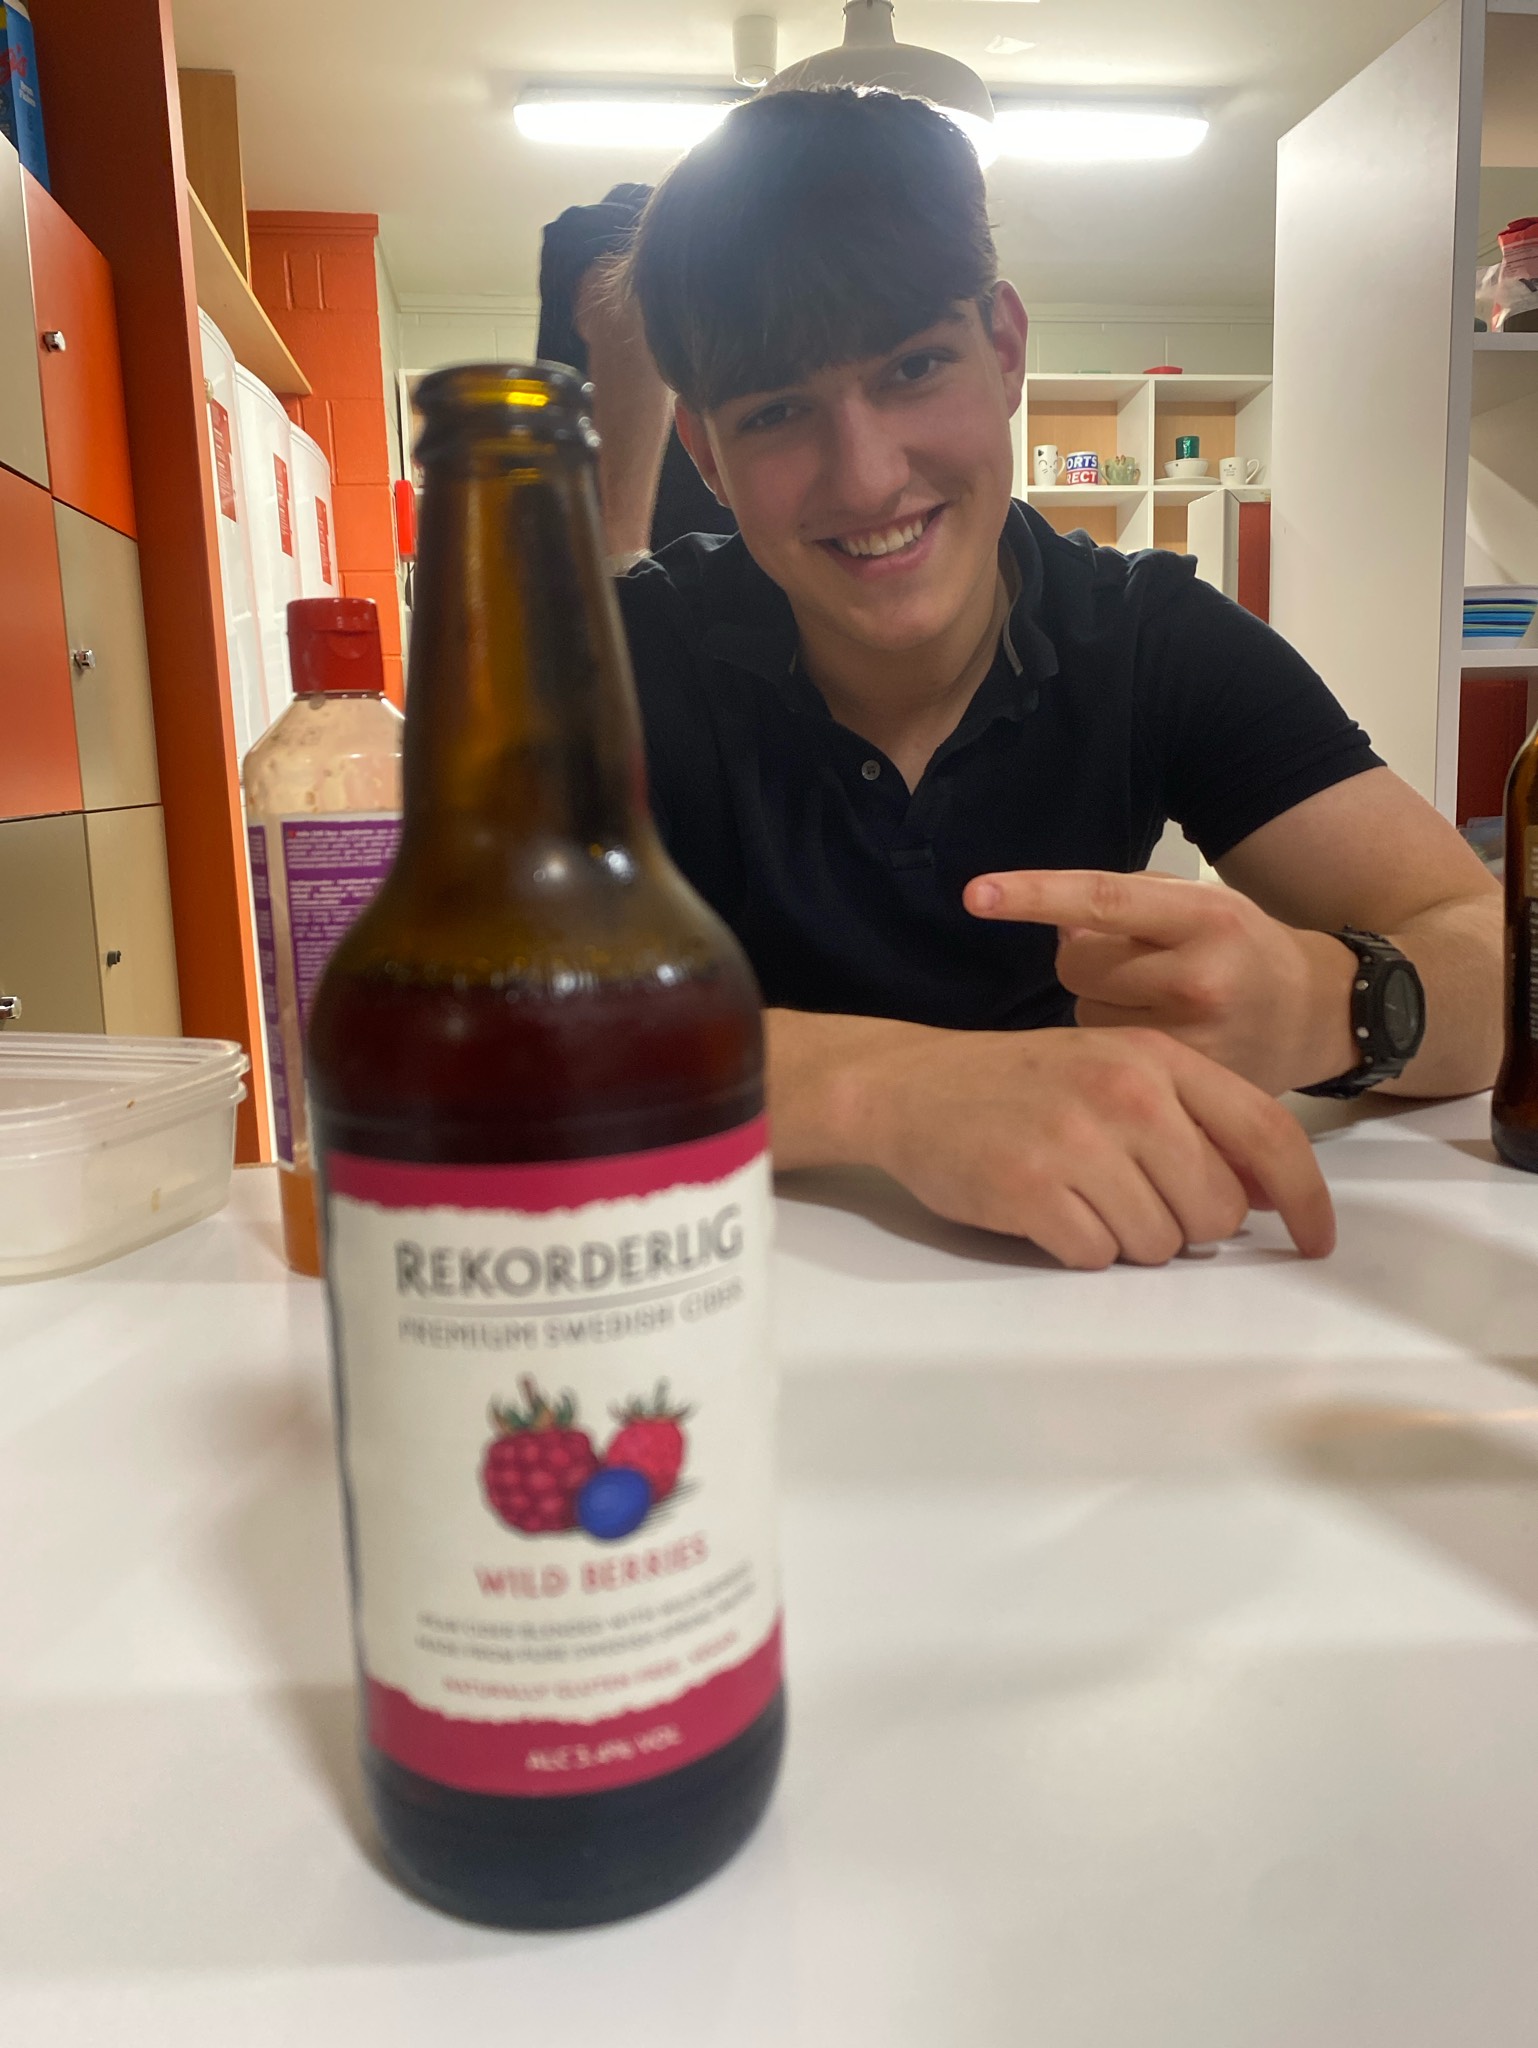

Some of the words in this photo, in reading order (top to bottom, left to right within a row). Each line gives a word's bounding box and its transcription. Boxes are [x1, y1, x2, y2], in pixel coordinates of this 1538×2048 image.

[395, 1203, 744, 1297] REKORDERLIG
[399, 1316, 538, 1350] PREMIUM
[545, 1306, 673, 1347] SWEDISH
[475, 1564, 568, 1597] WILD
[581, 1534, 707, 1592] BERRIES
